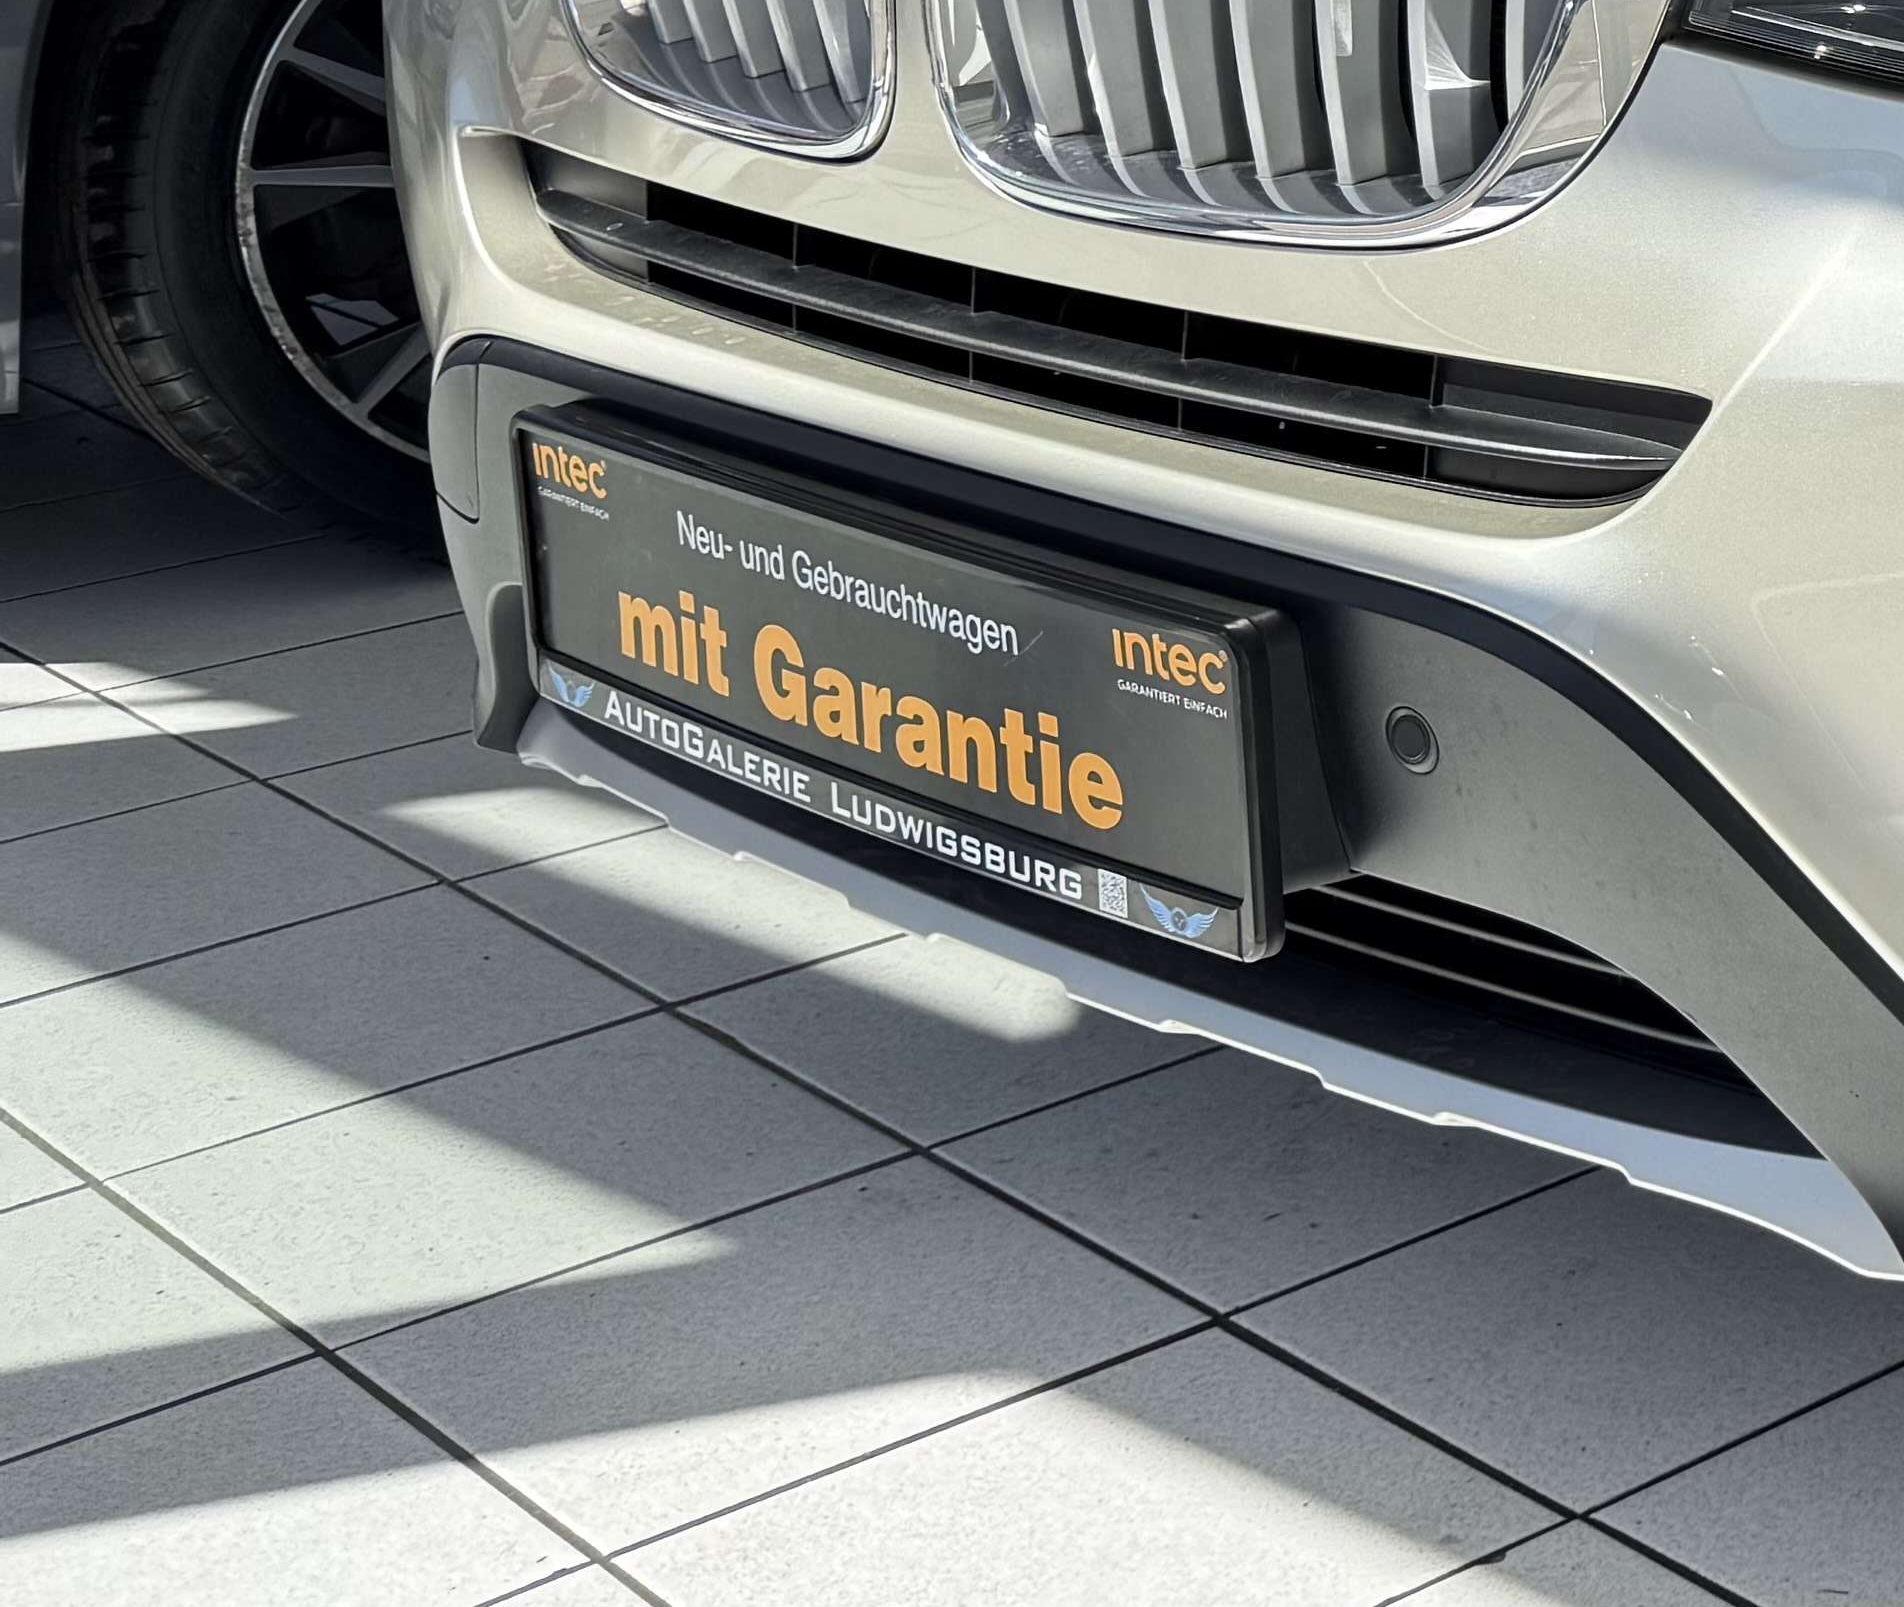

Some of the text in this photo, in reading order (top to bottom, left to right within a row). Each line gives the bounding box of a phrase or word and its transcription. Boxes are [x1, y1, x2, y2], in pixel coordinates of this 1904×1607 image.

[677, 510, 1019, 656] Neu- und Gebrauchtwagen
[618, 590, 1124, 831] mit Garantie
[1117, 679, 1228, 720] GARANTIERT EINFACH
[831, 781, 1083, 900] LUDWIGSBURG
